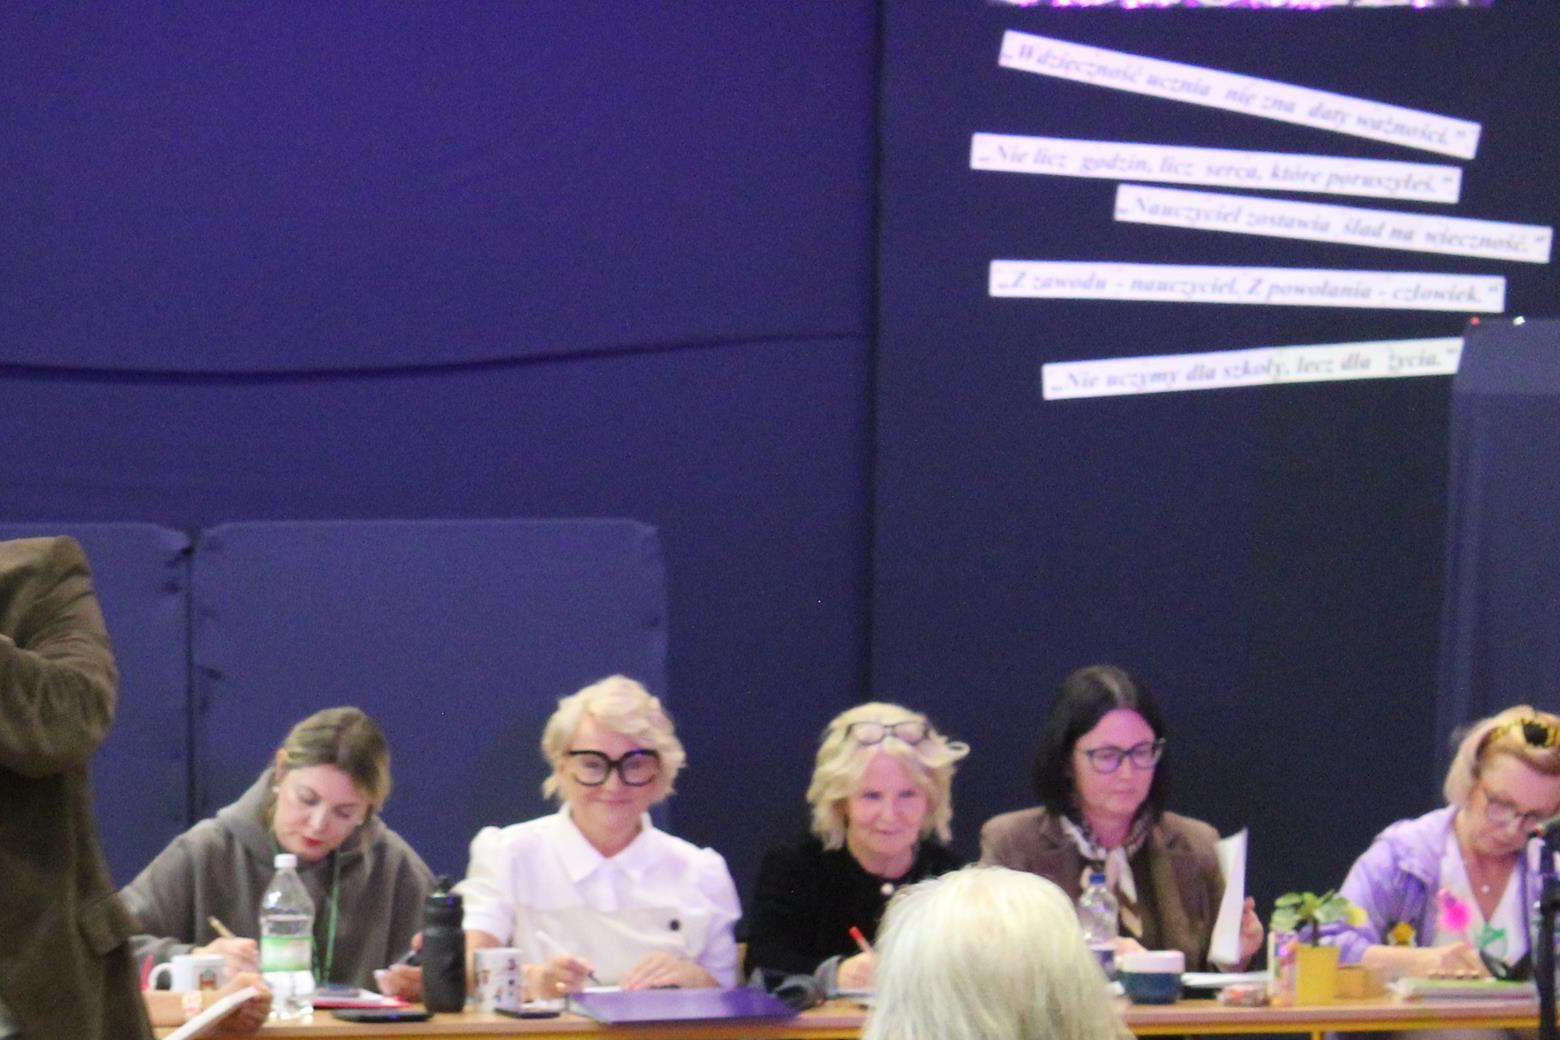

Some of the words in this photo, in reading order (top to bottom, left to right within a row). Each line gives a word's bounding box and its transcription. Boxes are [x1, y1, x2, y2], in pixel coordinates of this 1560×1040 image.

[1146, 75, 1211, 97] ucznia
[1263, 96, 1296, 114] zna
[1308, 102, 1350, 127] daty
[1034, 146, 1067, 168] licz
[1080, 153, 1152, 174] godzin,
[1160, 156, 1193, 177] licz
[1206, 164, 1262, 182] serca,
[1271, 162, 1320, 184] które
[1245, 211, 1331, 233] zostawia
[1390, 226, 1414, 241] na
[1033, 272, 1107, 291] zawodu
[1186, 364, 1216, 382] dla
[1296, 355, 1334, 375] lecz
[1341, 353, 1371, 371] dla
